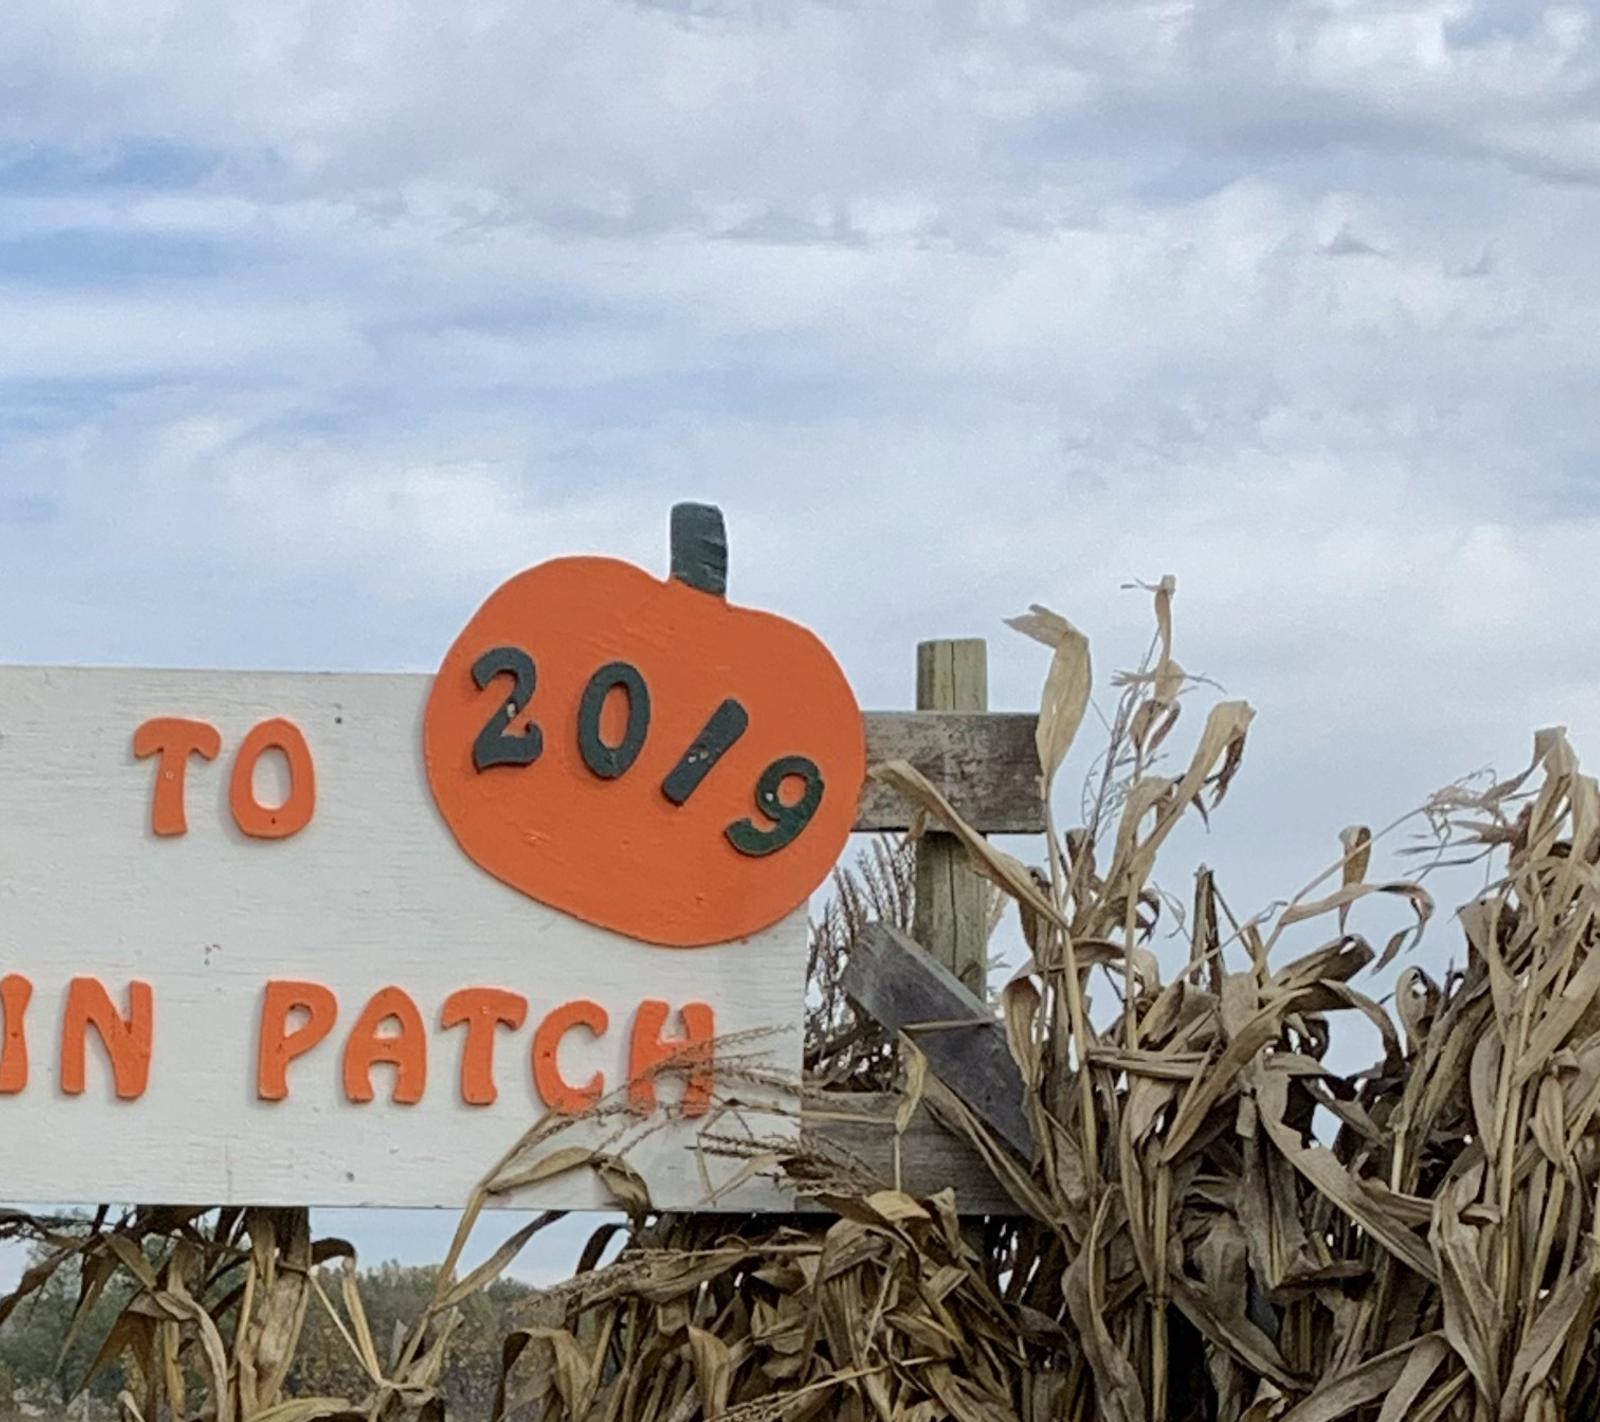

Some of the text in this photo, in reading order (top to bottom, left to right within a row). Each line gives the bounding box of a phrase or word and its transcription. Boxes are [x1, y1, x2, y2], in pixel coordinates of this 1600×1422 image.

[133, 717, 316, 841] TO
[470, 646, 826, 857] 2019
[256, 980, 716, 1119] PATCH
